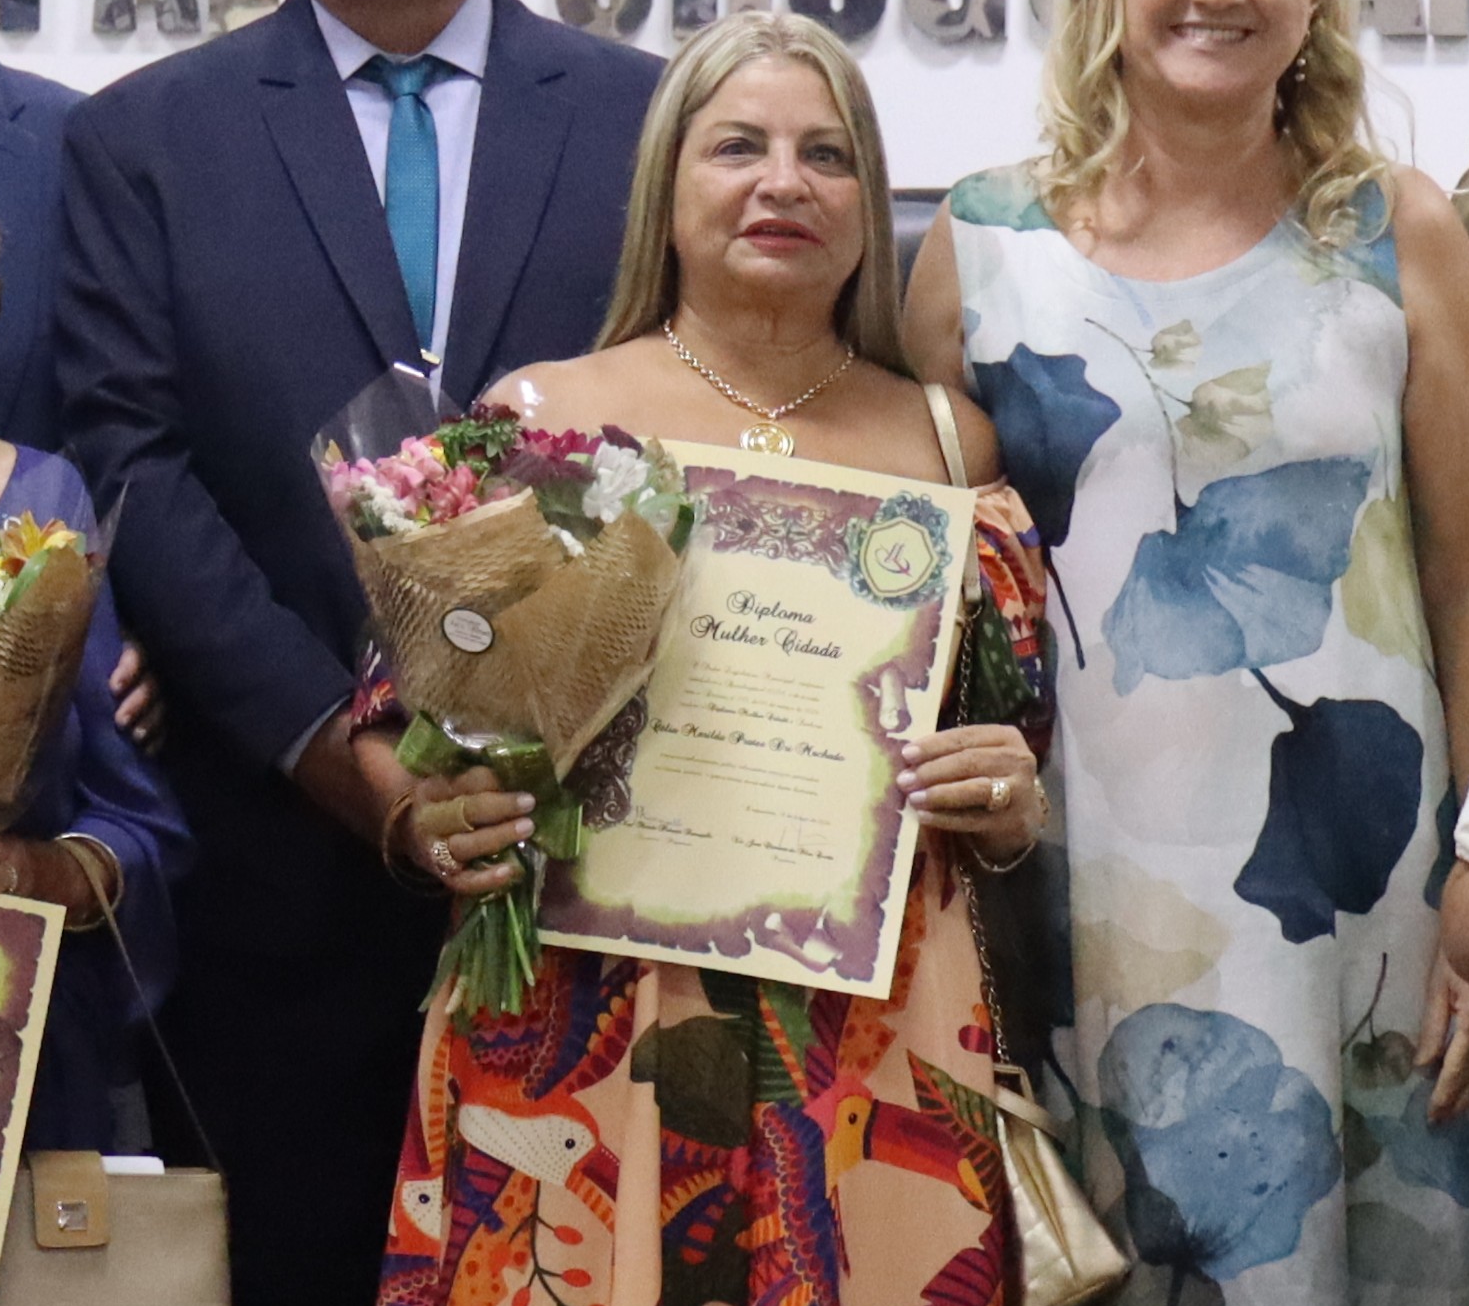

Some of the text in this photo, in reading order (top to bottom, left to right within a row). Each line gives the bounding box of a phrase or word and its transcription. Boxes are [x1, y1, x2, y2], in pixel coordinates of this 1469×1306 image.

[725, 590, 818, 625] Diploma
[690, 614, 842, 660] Mulher Cidadã
